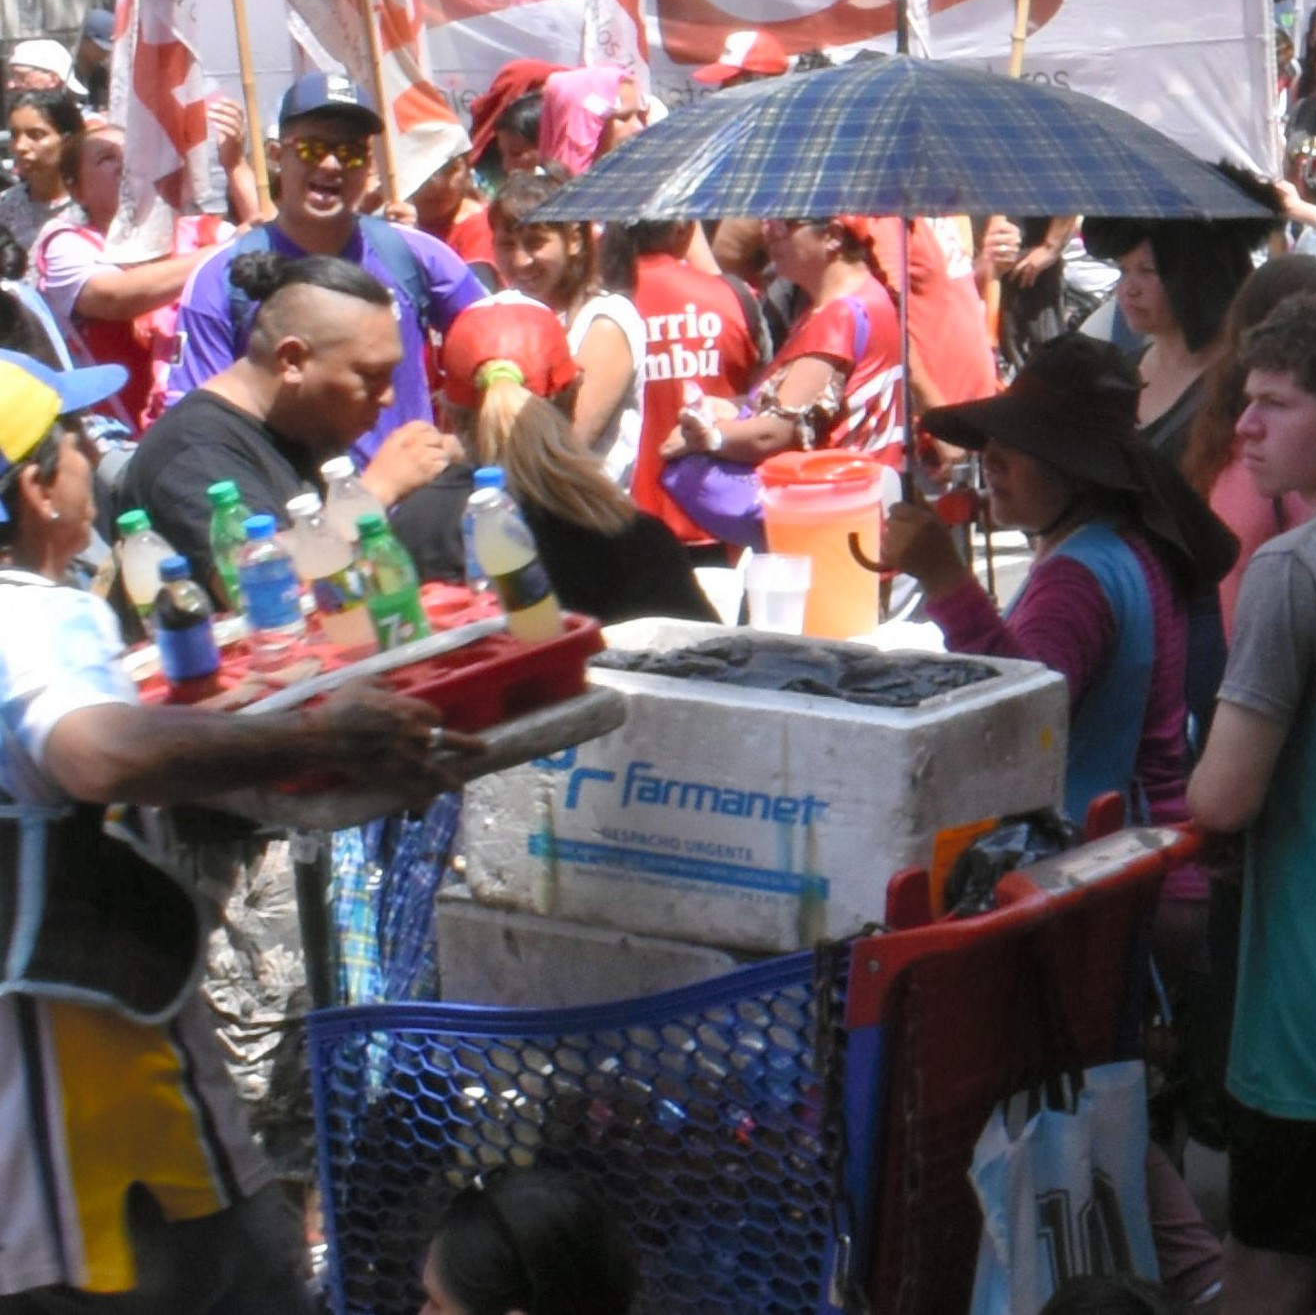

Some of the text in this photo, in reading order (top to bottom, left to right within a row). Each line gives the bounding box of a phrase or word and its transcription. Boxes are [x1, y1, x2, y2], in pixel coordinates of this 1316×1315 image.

[644, 302, 723, 342] rrio
[643, 338, 720, 381] mbú
[621, 761, 830, 826] farmanet
[682, 837, 755, 863] URGENTE
